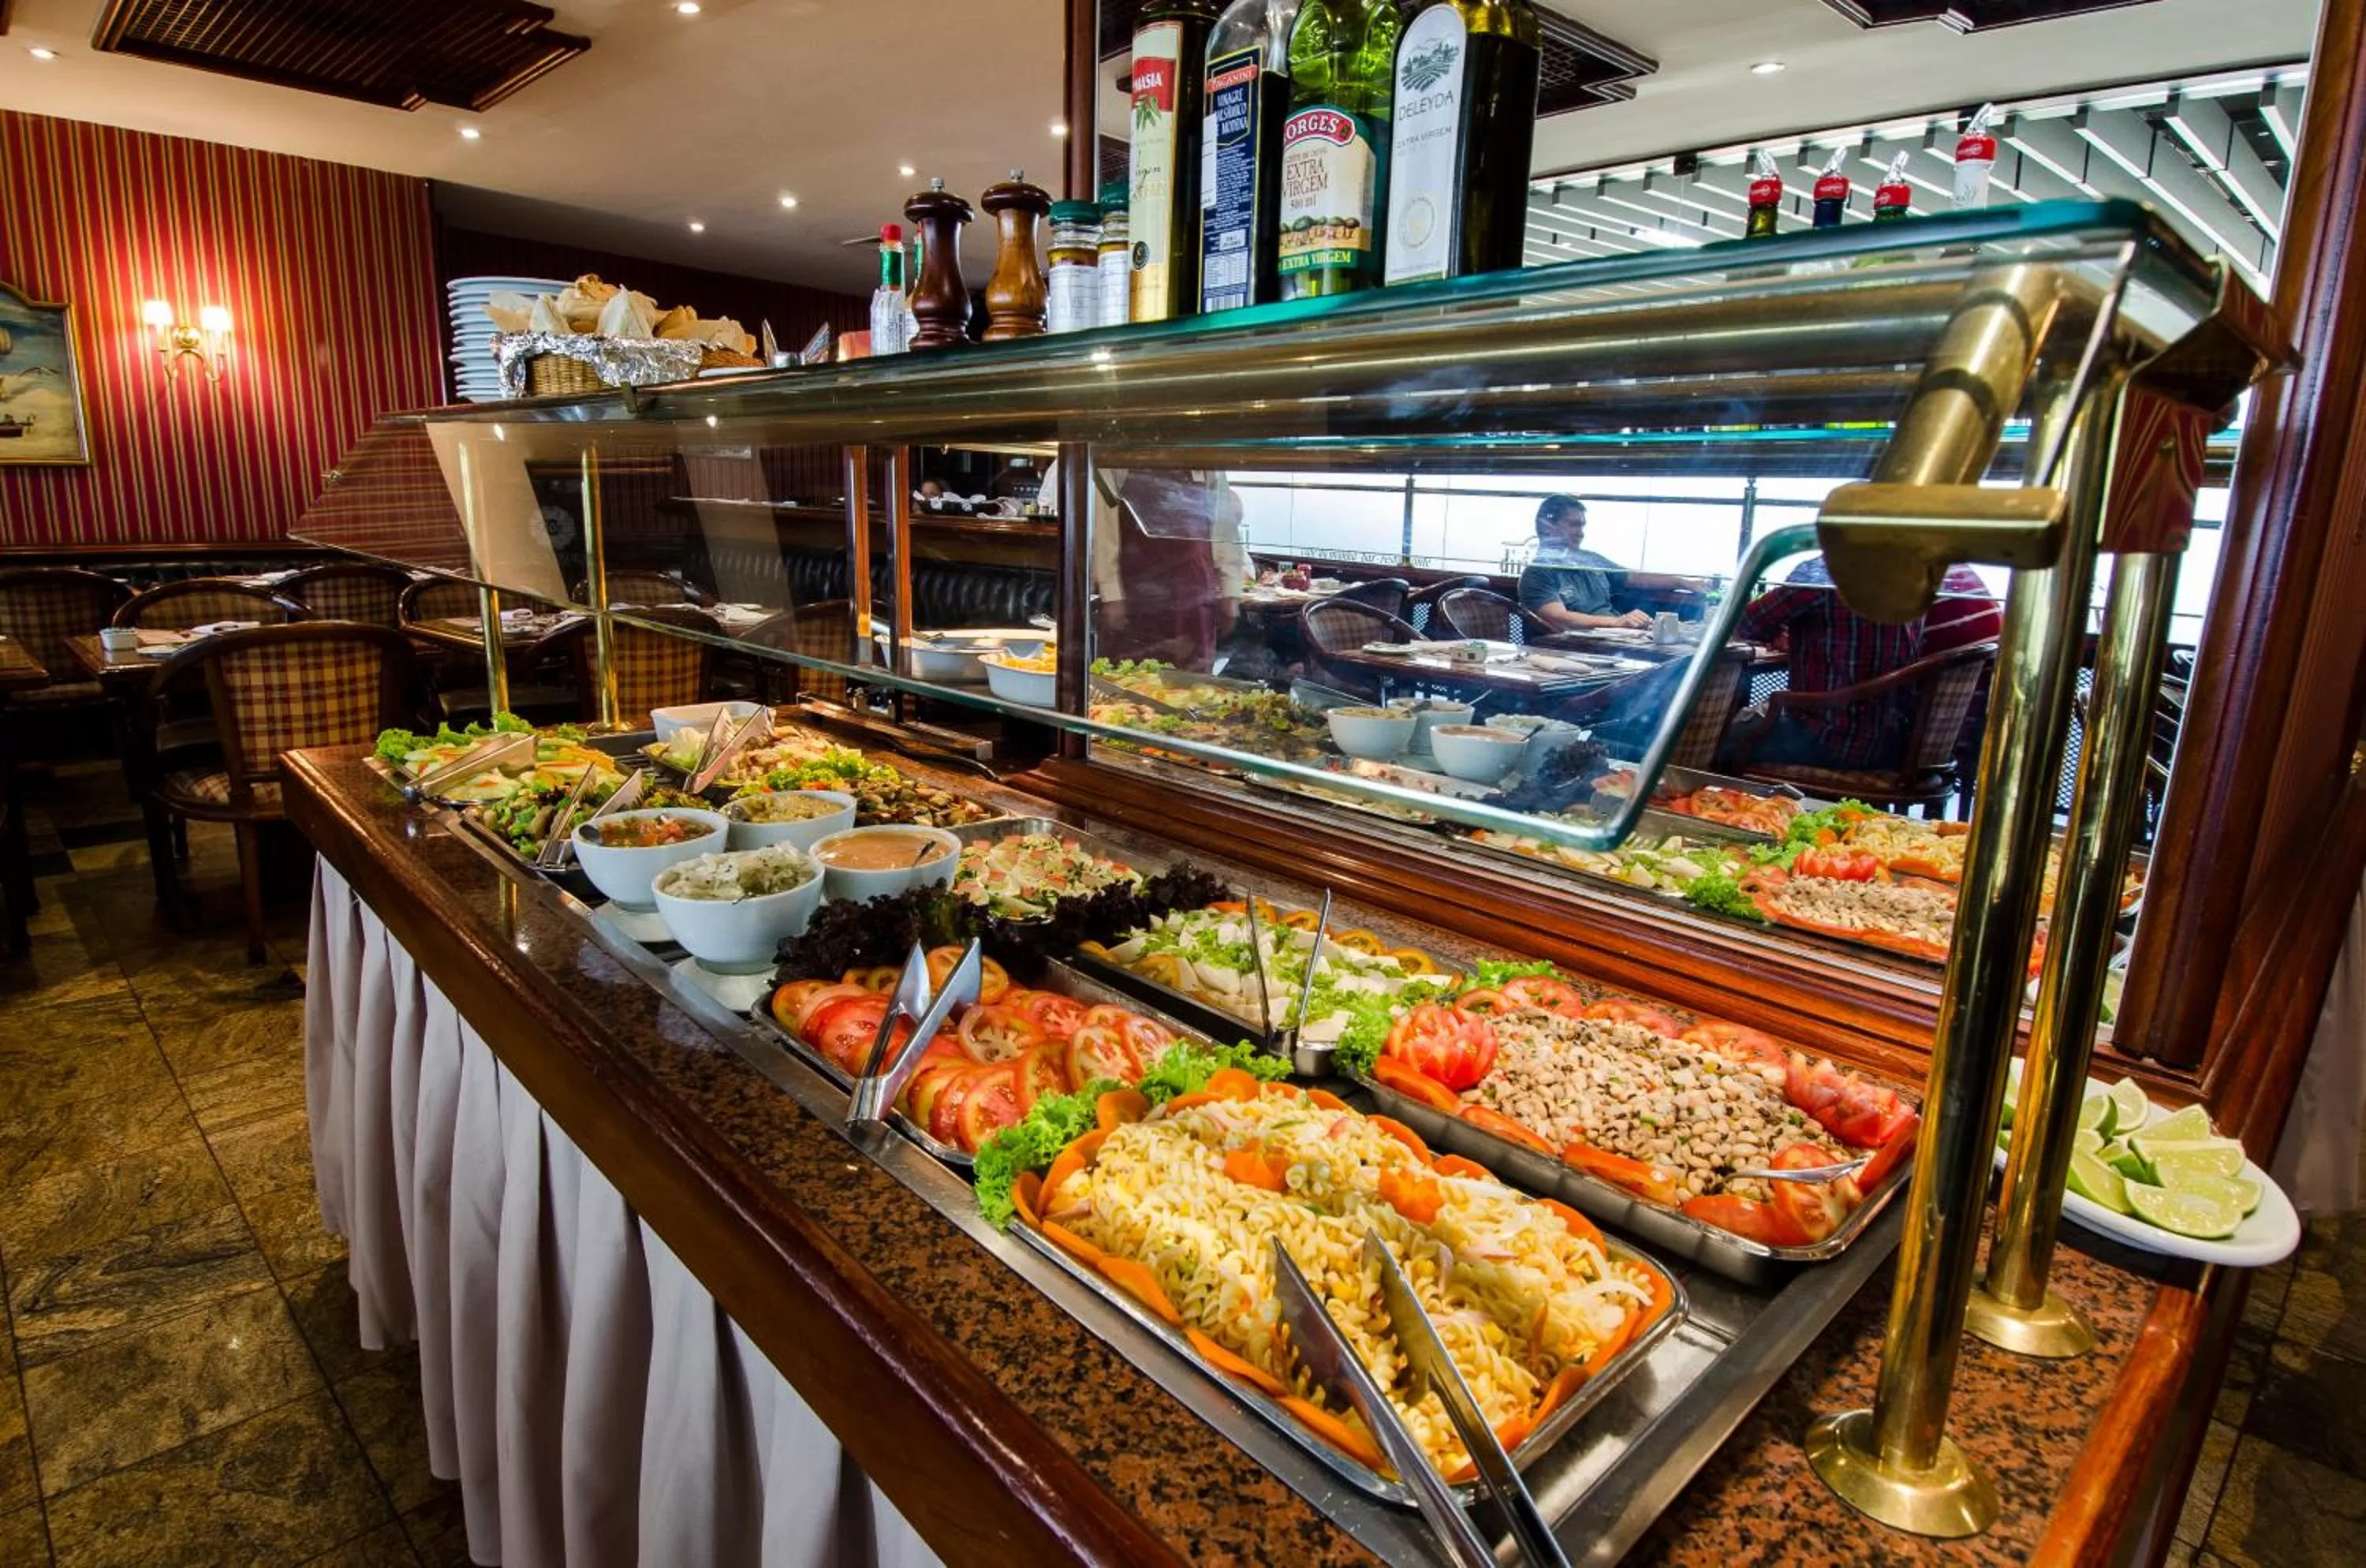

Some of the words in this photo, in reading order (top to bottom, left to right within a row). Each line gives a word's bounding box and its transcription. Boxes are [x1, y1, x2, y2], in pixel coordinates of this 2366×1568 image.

[1211, 69, 1252, 91] PAGANINI
[1399, 90, 1454, 121] DELEYDA
[1286, 114, 1339, 140] ORGES
[1286, 158, 1324, 181] EXTRA
[1282, 253, 1310, 271] EXTRA
[1312, 250, 1351, 264] VIRGEM
